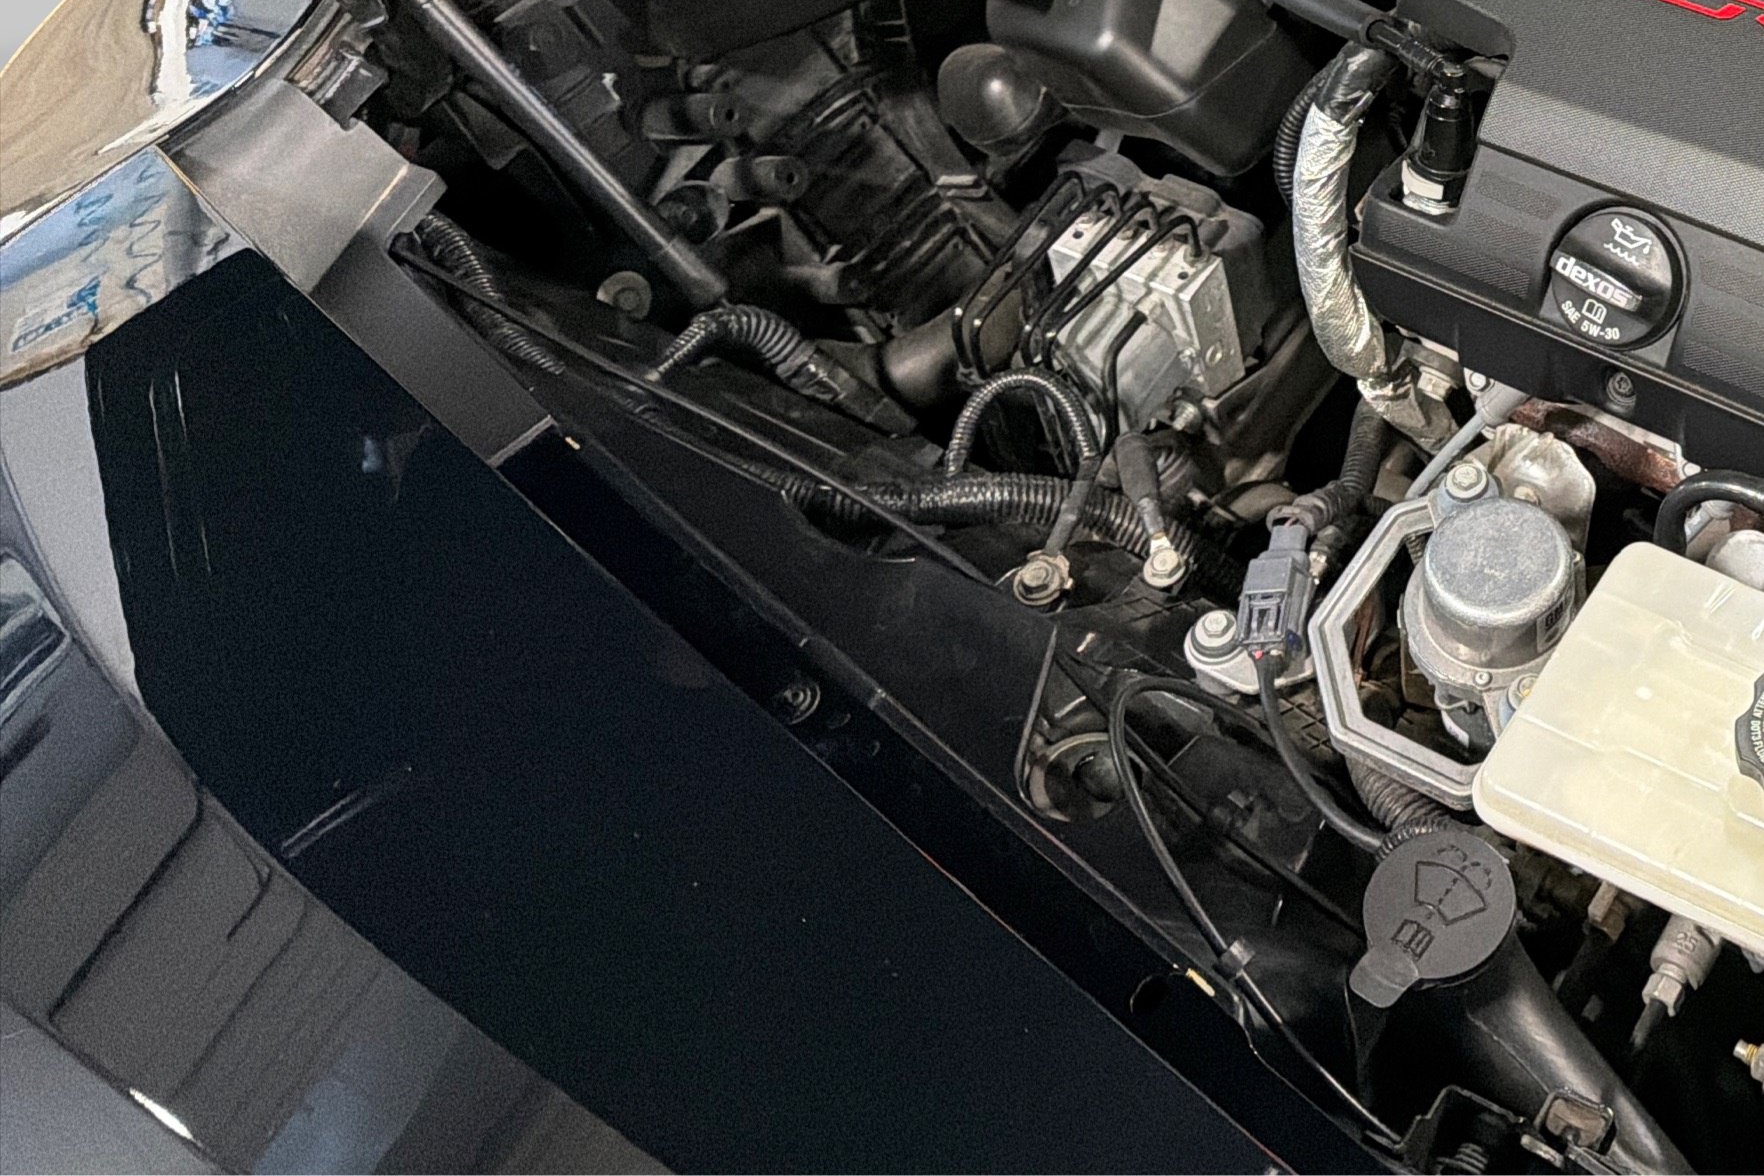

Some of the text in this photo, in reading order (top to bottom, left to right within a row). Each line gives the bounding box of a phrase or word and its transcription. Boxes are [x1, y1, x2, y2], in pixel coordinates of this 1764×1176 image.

[1555, 256, 1634, 308] dexos
[1561, 300, 1620, 340] SAE 5W-30
